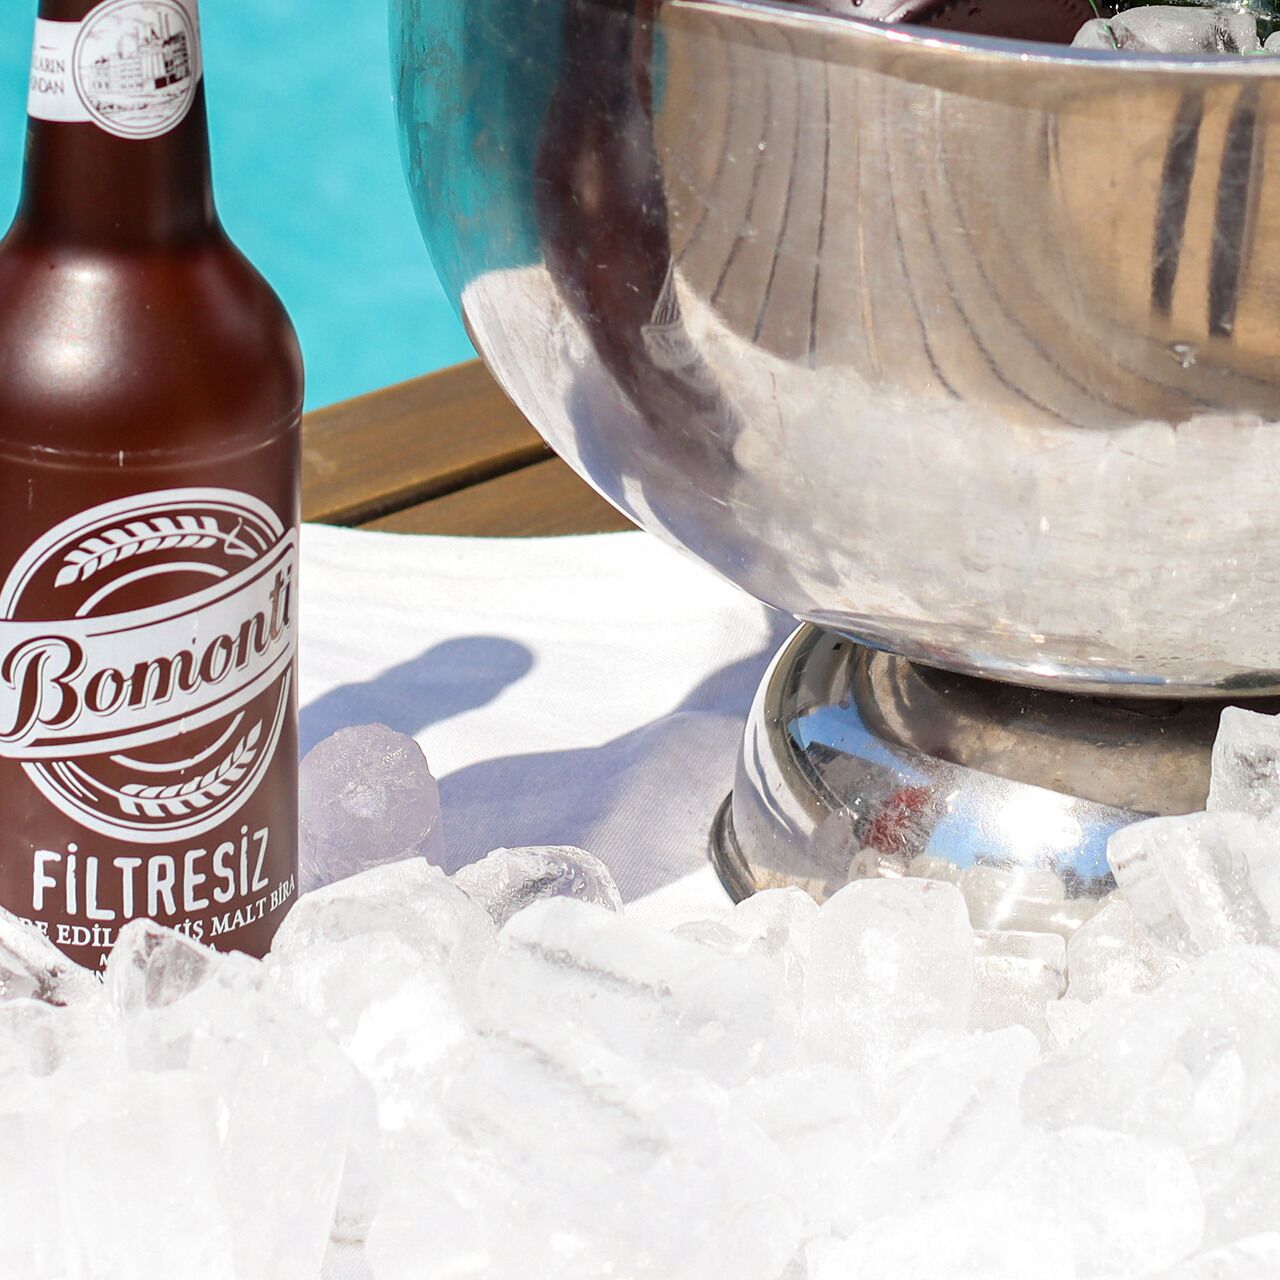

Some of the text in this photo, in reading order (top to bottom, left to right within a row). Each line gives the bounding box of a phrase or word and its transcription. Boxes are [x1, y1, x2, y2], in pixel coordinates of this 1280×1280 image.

[32, 824, 270, 921] FİLTRESİZ
[210, 898, 267, 938] MALT
[269, 873, 297, 912] BİRA
